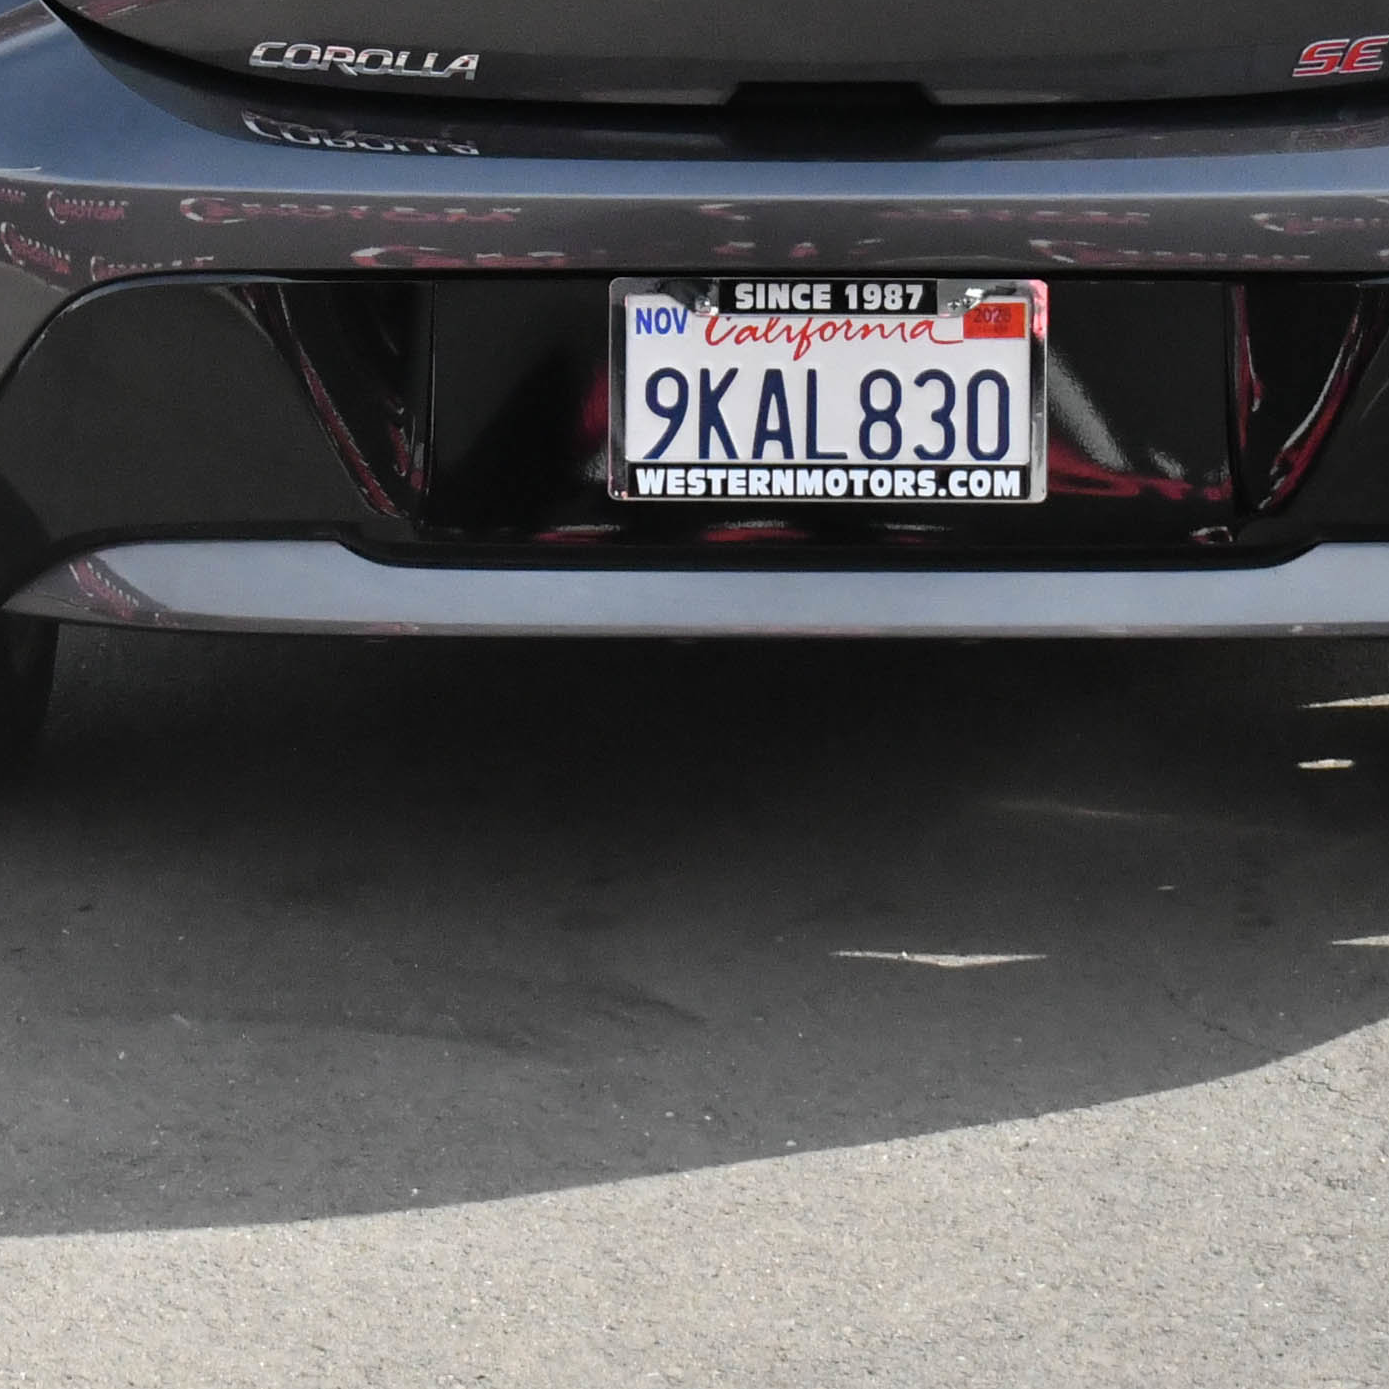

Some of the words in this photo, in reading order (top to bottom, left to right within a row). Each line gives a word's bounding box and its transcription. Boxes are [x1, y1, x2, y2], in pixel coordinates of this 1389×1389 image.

[248, 41, 480, 81] COROLLA
[734, 283, 831, 311] SINCE
[844, 284, 924, 310] 1987
[635, 307, 689, 335] NOV
[705, 315, 964, 361] California
[643, 367, 1011, 461] 9KAL830
[635, 468, 1021, 497] WESTERNMOTORS.COM
